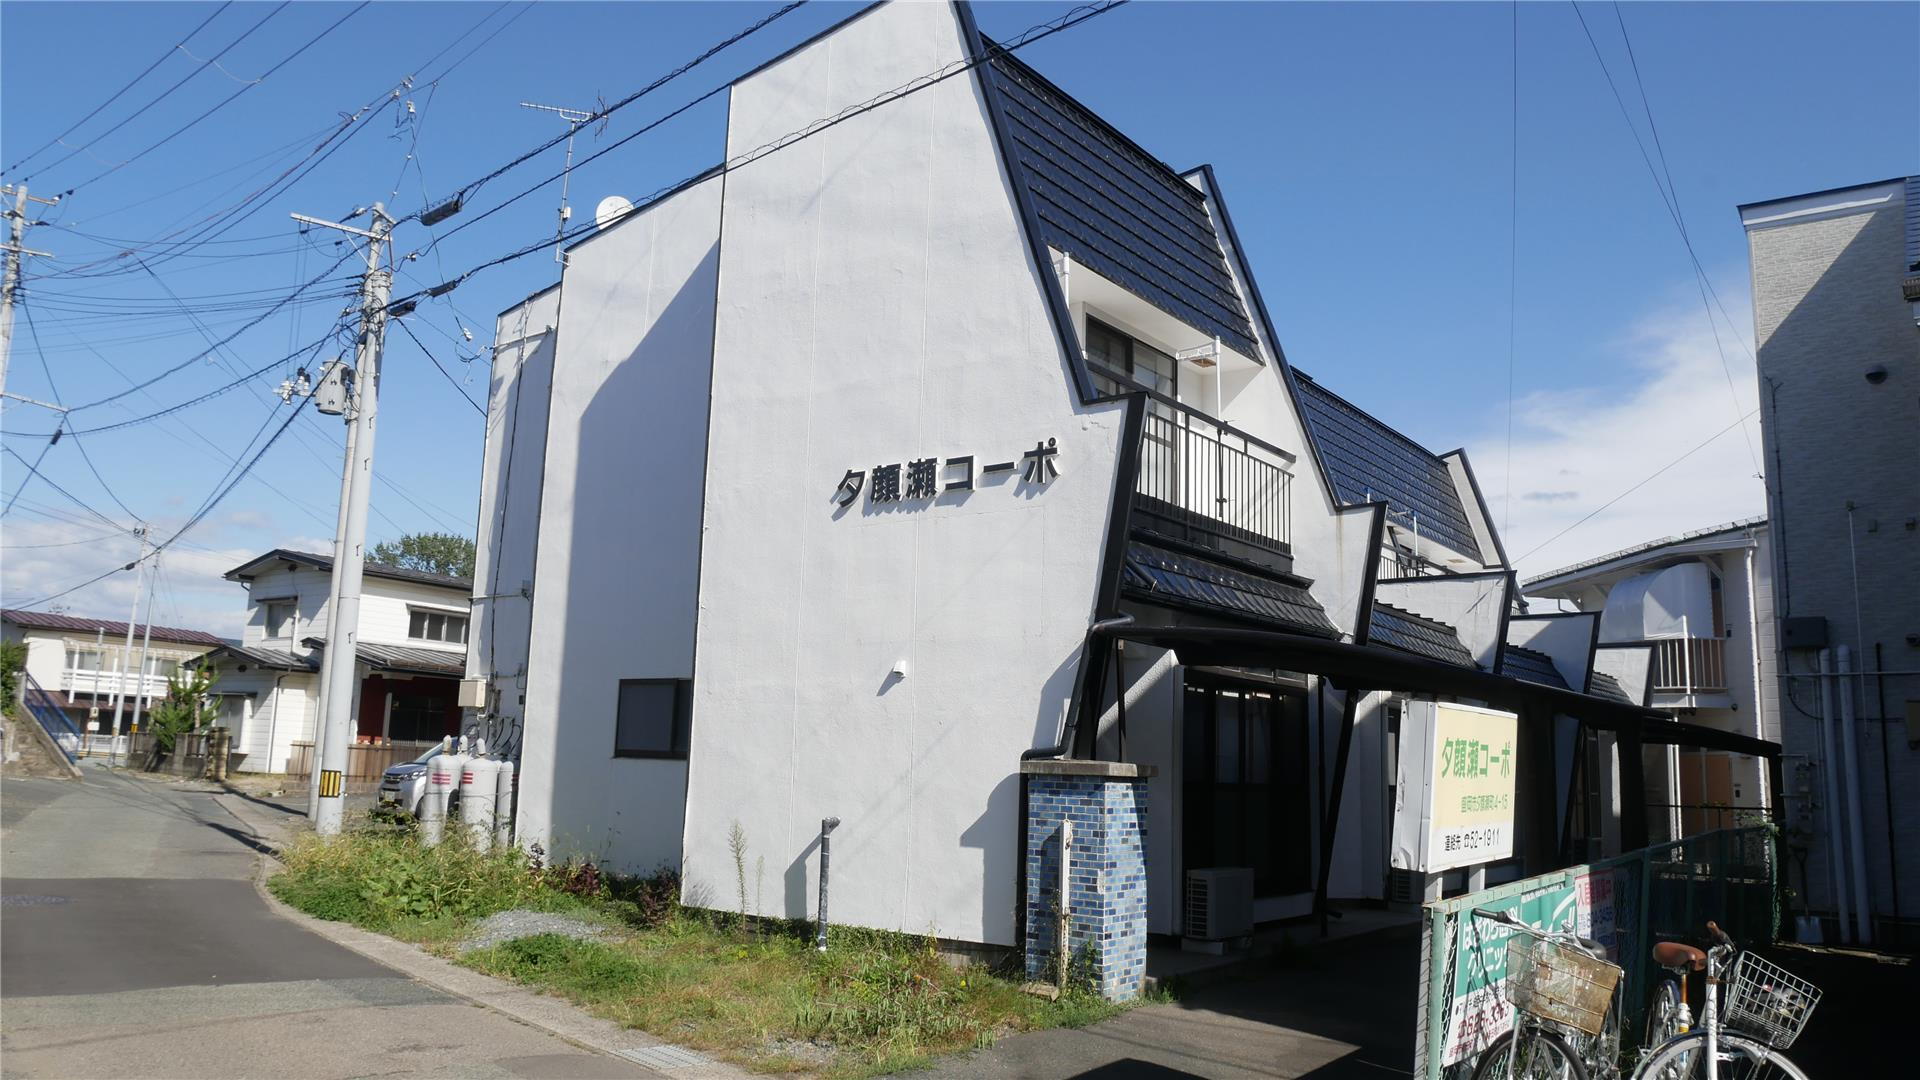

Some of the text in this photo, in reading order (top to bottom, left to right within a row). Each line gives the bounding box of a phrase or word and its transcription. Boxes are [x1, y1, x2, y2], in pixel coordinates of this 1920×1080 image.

[837, 437, 1061, 508] 夕顔瀬コーポ
[1441, 737, 1511, 779] 夕顔瀬コーポ
